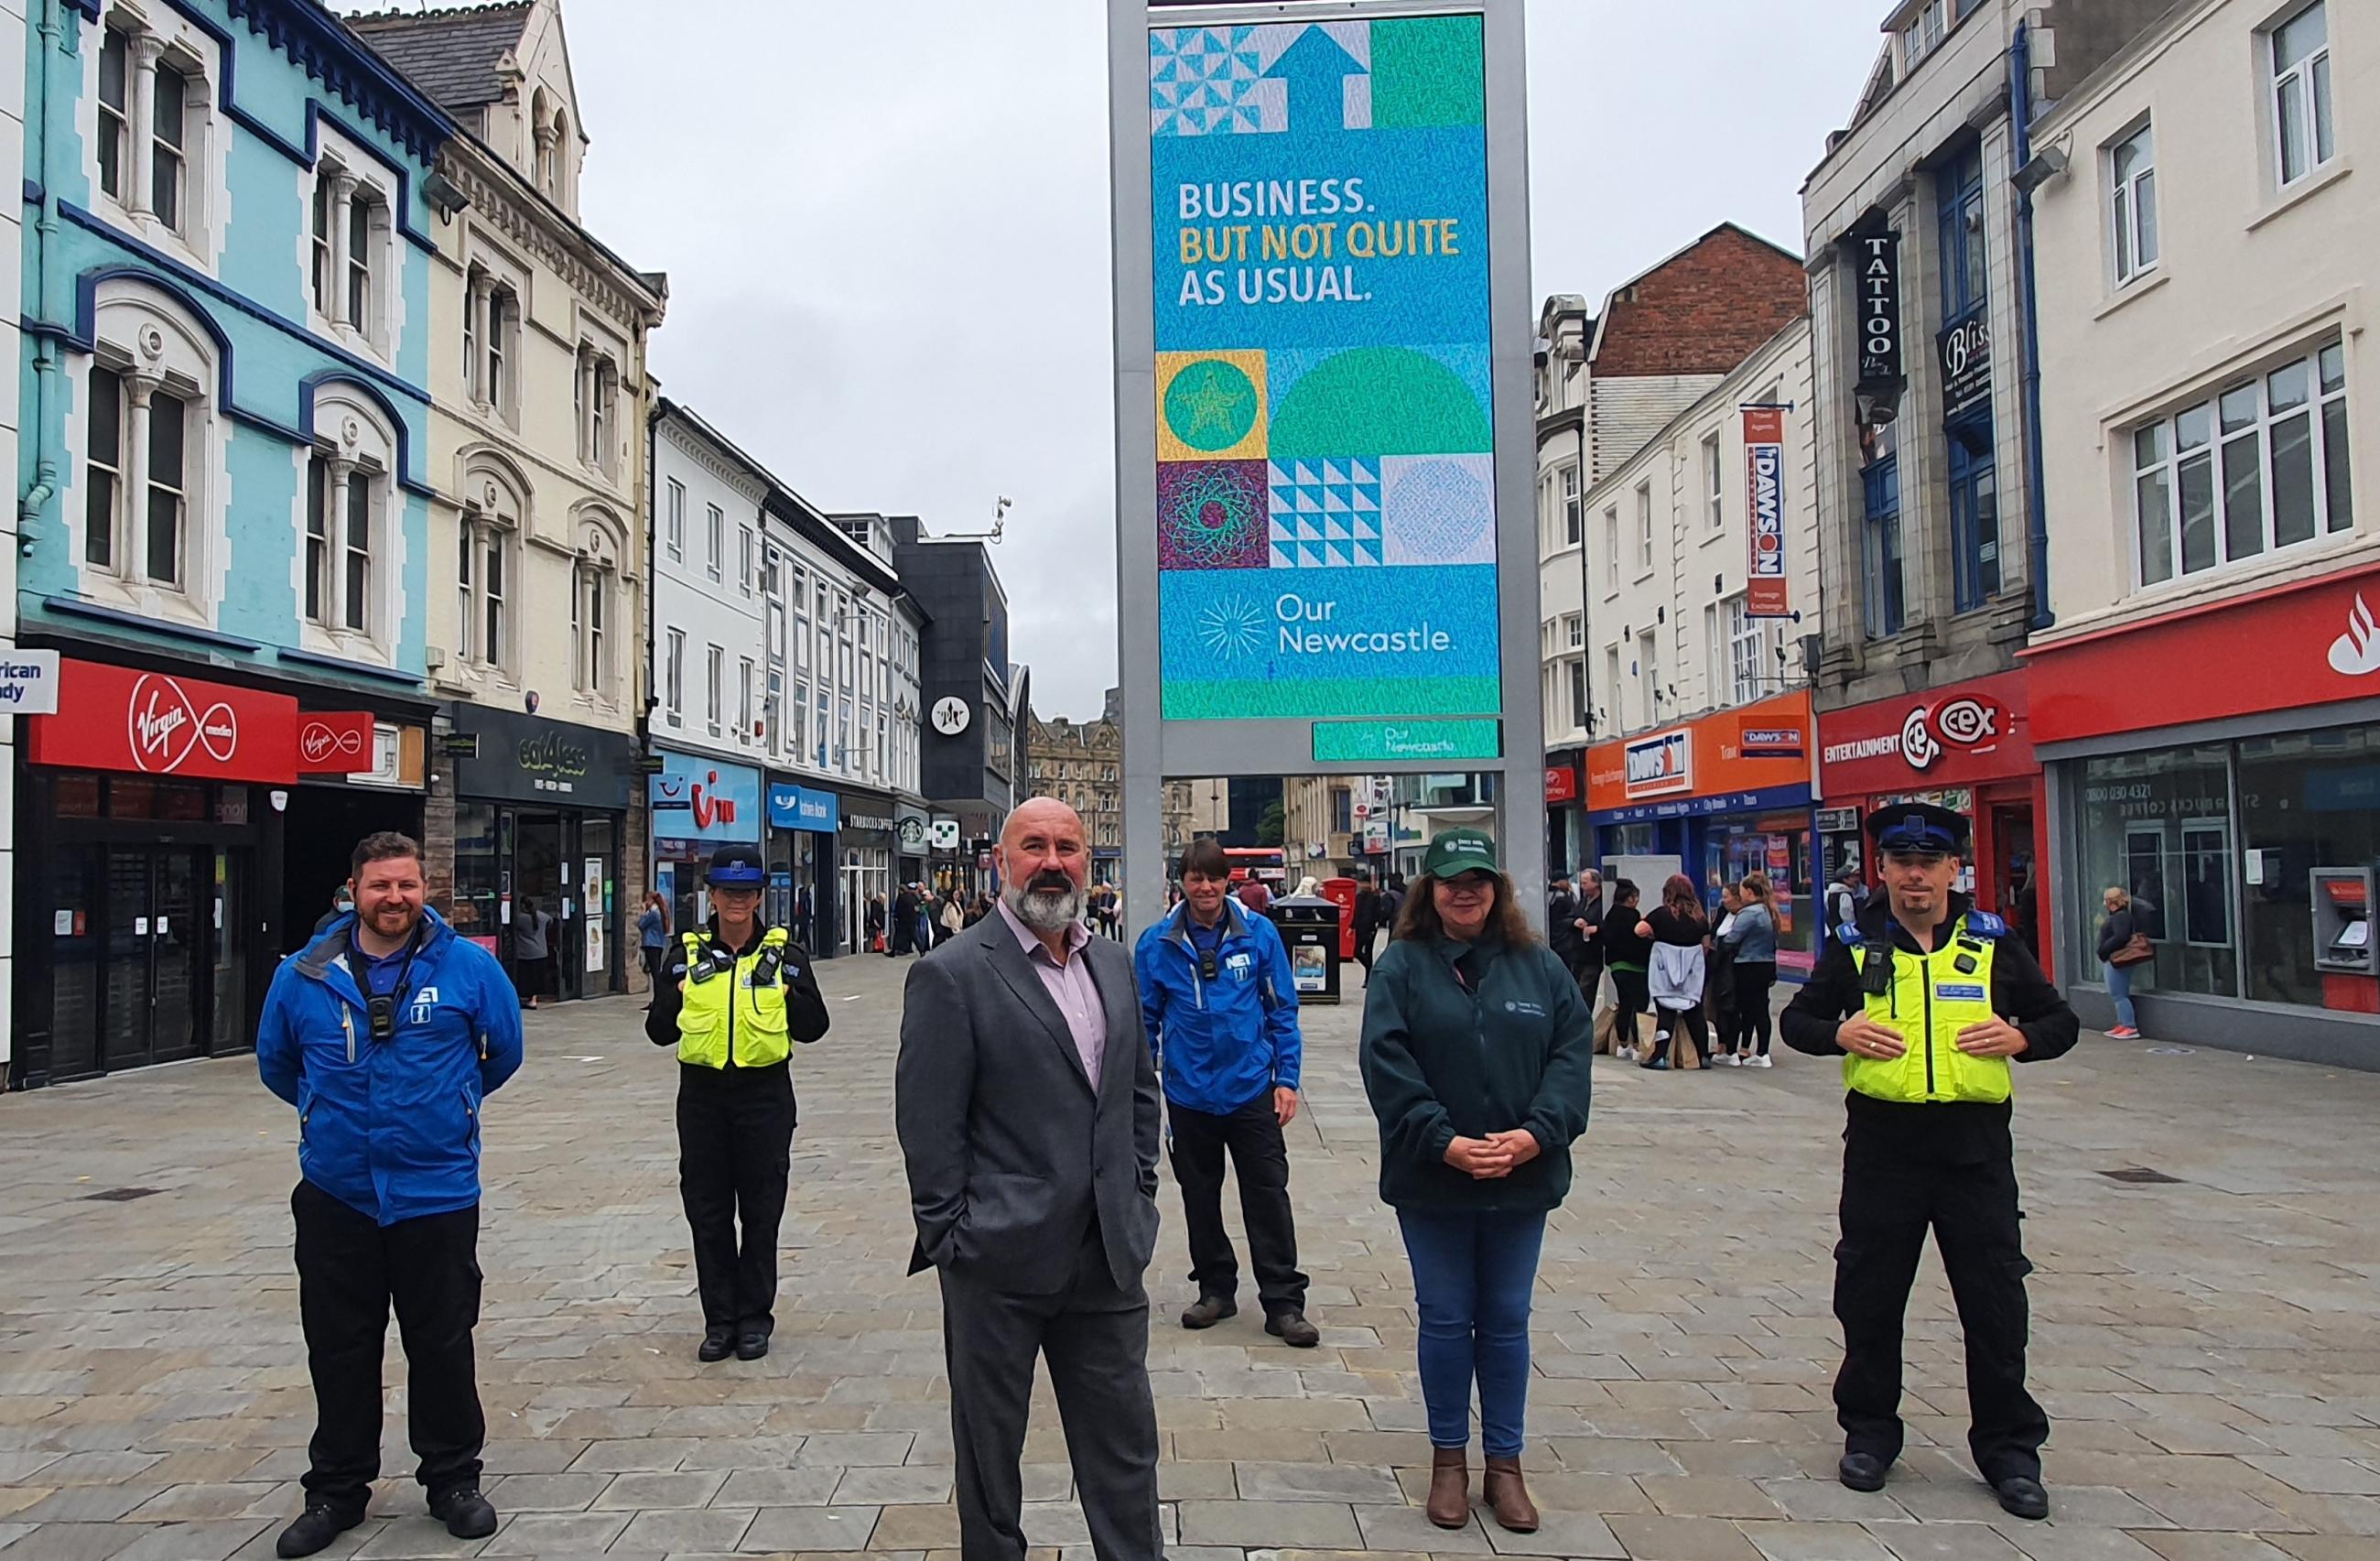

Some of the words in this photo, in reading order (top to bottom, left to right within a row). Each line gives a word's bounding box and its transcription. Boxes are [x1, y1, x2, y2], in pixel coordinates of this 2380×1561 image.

[1179, 178, 1375, 219] BUSINESS.
[1179, 224, 1251, 264] BUT
[1261, 222, 1337, 260] NOT
[1346, 218, 1460, 257] QUITE
[1179, 269, 1226, 306] AS
[1238, 266, 1372, 305] USUAL.
[1865, 238, 1891, 354] TATTOO
[1756, 458, 1779, 574] DAWSON
[1276, 593, 1336, 622] Our
[1280, 621, 1458, 654] Newcastle.
[137, 689, 187, 758] Virgin
[1628, 740, 1684, 782] DAWSON
[1824, 733, 1901, 764] ENTERTAINMENT
[2128, 783, 2151, 799] 4321
